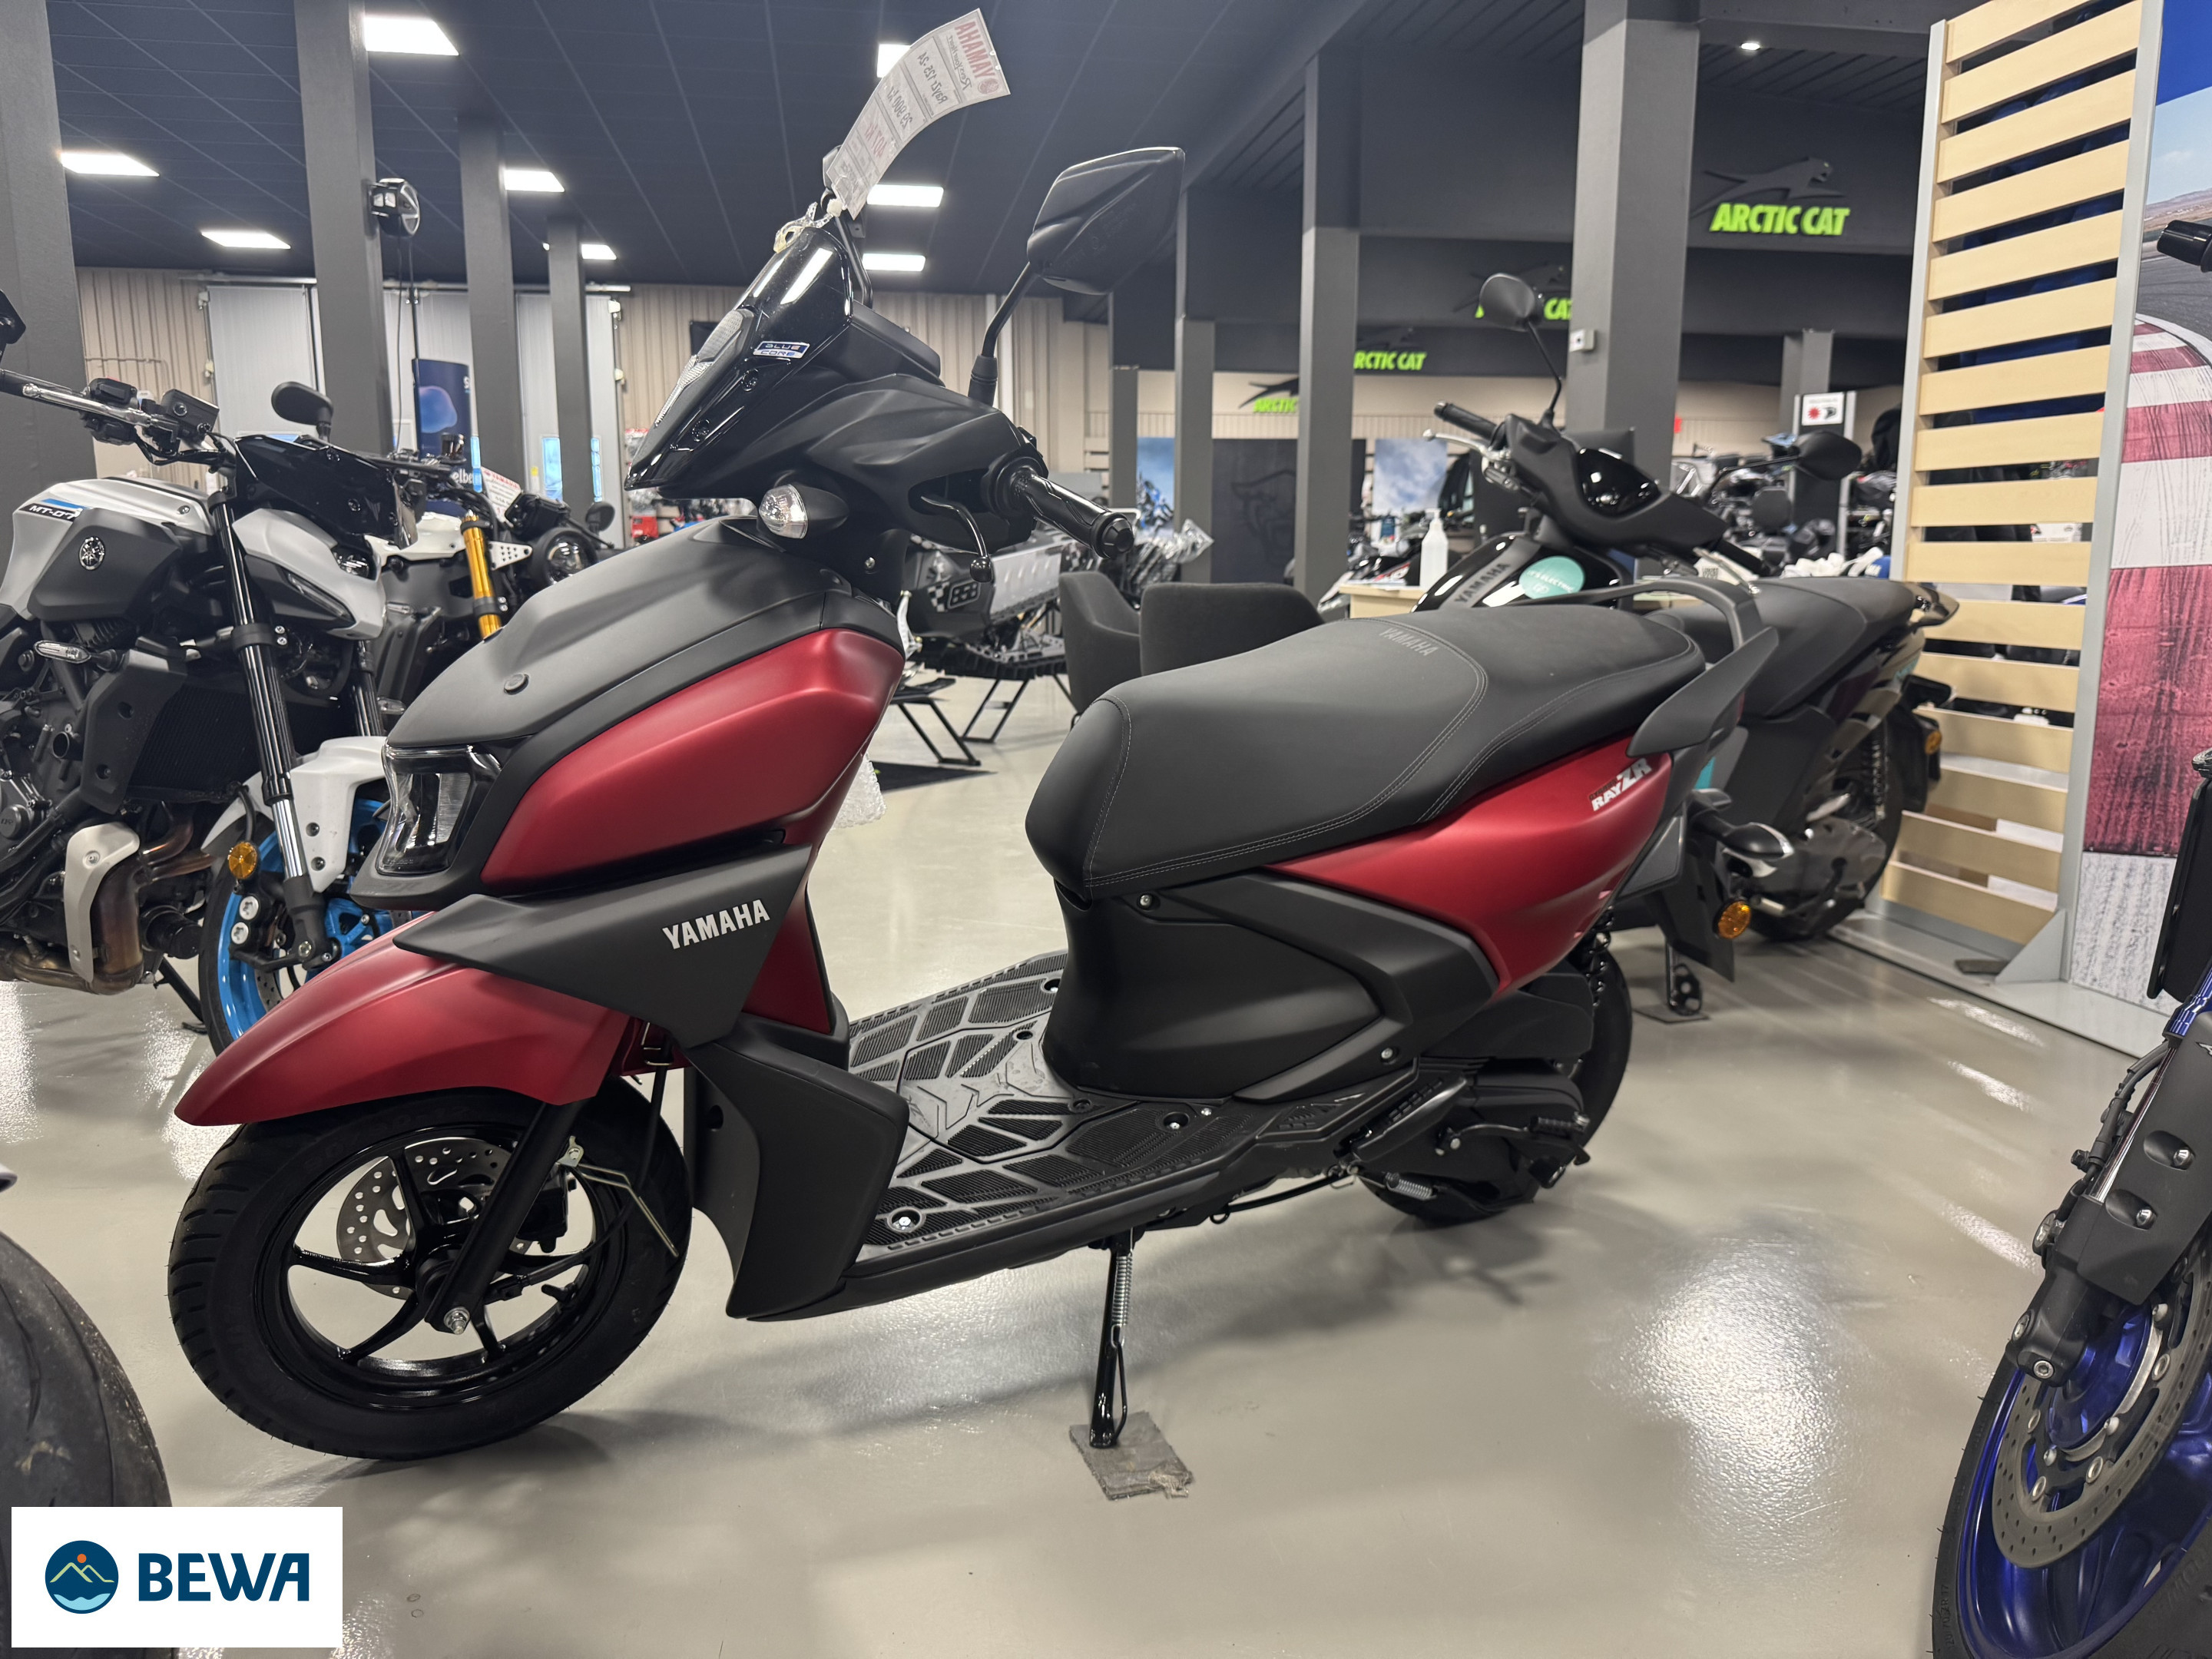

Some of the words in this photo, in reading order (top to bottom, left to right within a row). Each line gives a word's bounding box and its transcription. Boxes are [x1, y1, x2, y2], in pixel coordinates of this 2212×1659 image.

[1710, 203, 1801, 234] ARCTIC
[1801, 207, 1850, 236] CAT
[1396, 352, 1427, 370] CAT
[28, 505, 75, 520] MT-07
[952, 581, 979, 604] 858
[1455, 563, 1510, 604] YAMAHA
[1379, 628, 1439, 657] YAMAHA
[663, 899, 770, 949] YAMAHA
